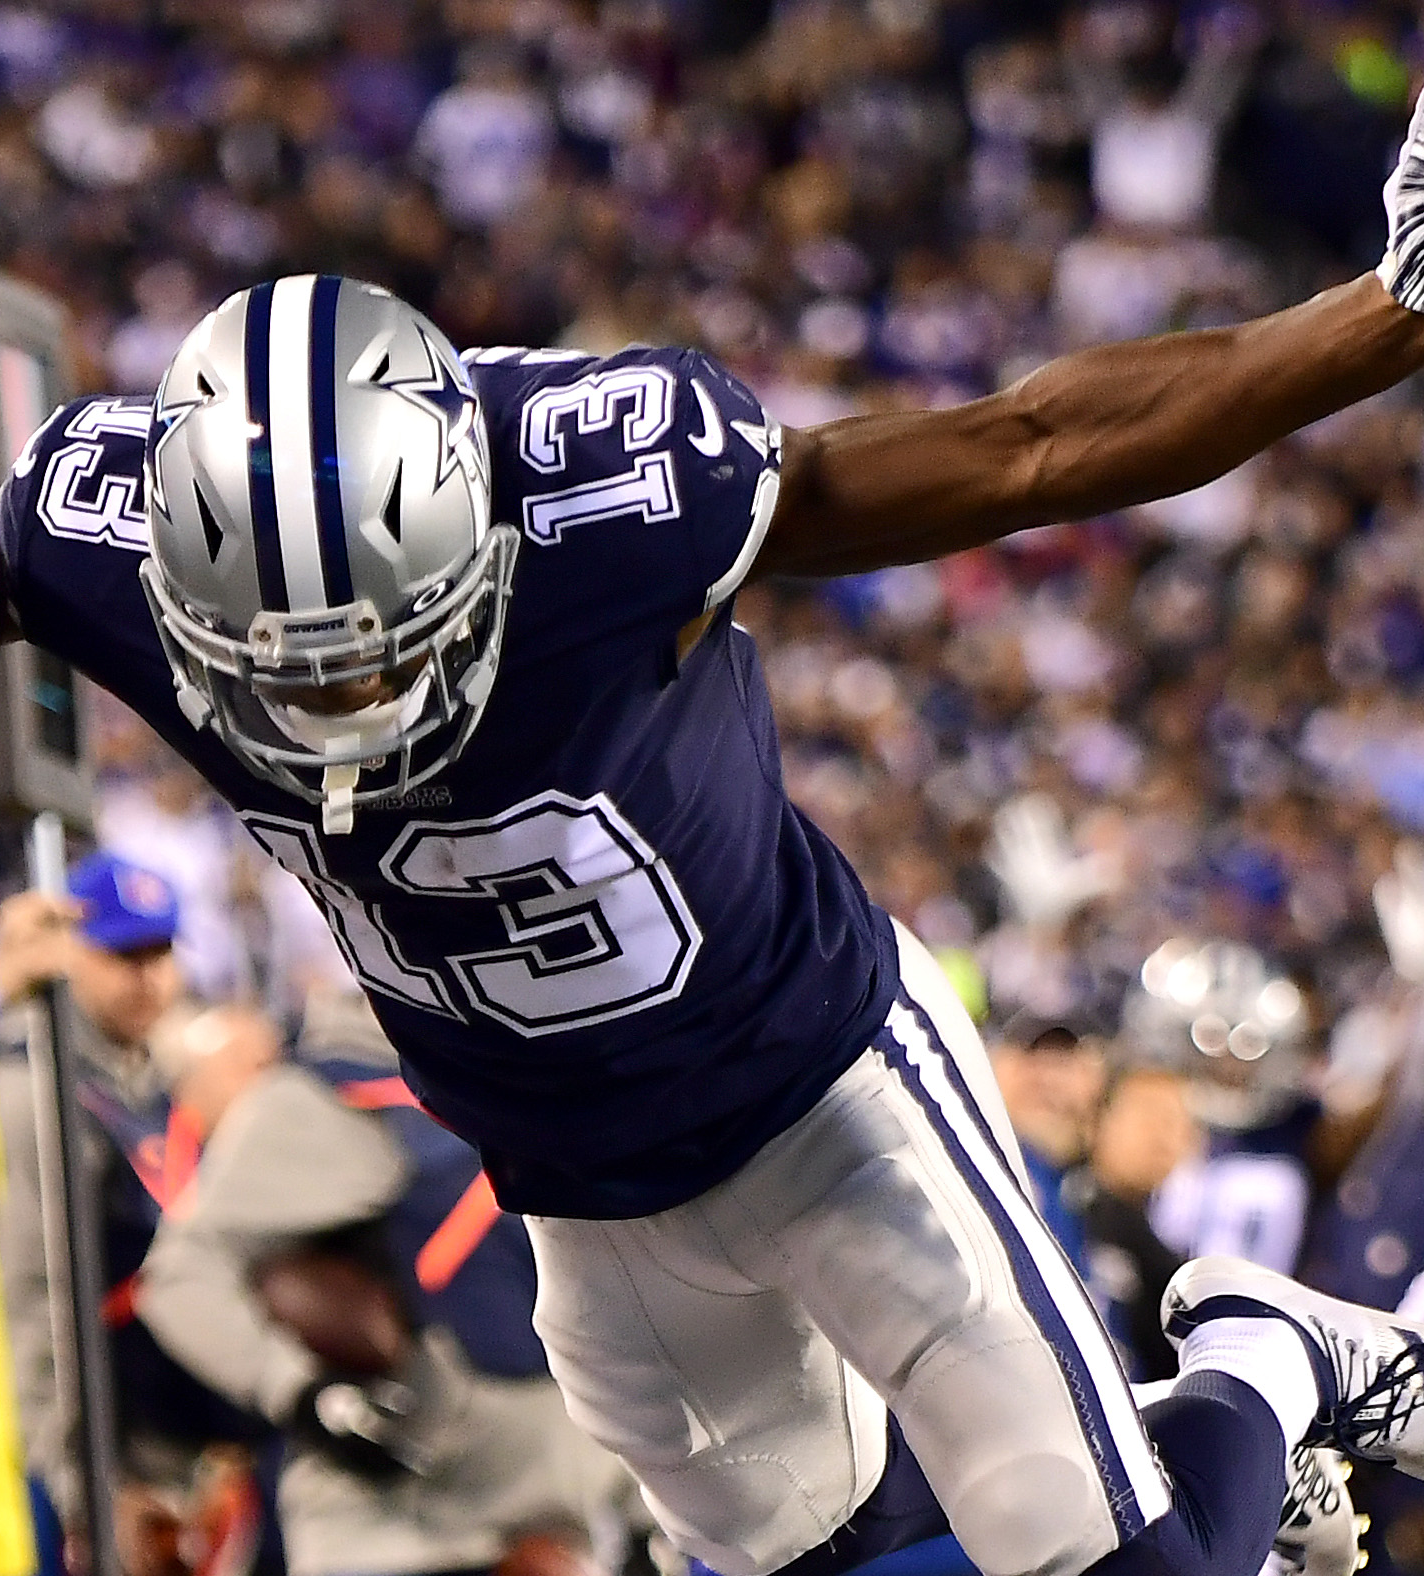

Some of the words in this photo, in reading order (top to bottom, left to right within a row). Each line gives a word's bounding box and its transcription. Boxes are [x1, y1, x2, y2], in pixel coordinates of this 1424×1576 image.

[36, 401, 152, 553] 13
[519, 366, 680, 546] 13
[236, 789, 704, 1039] 13
